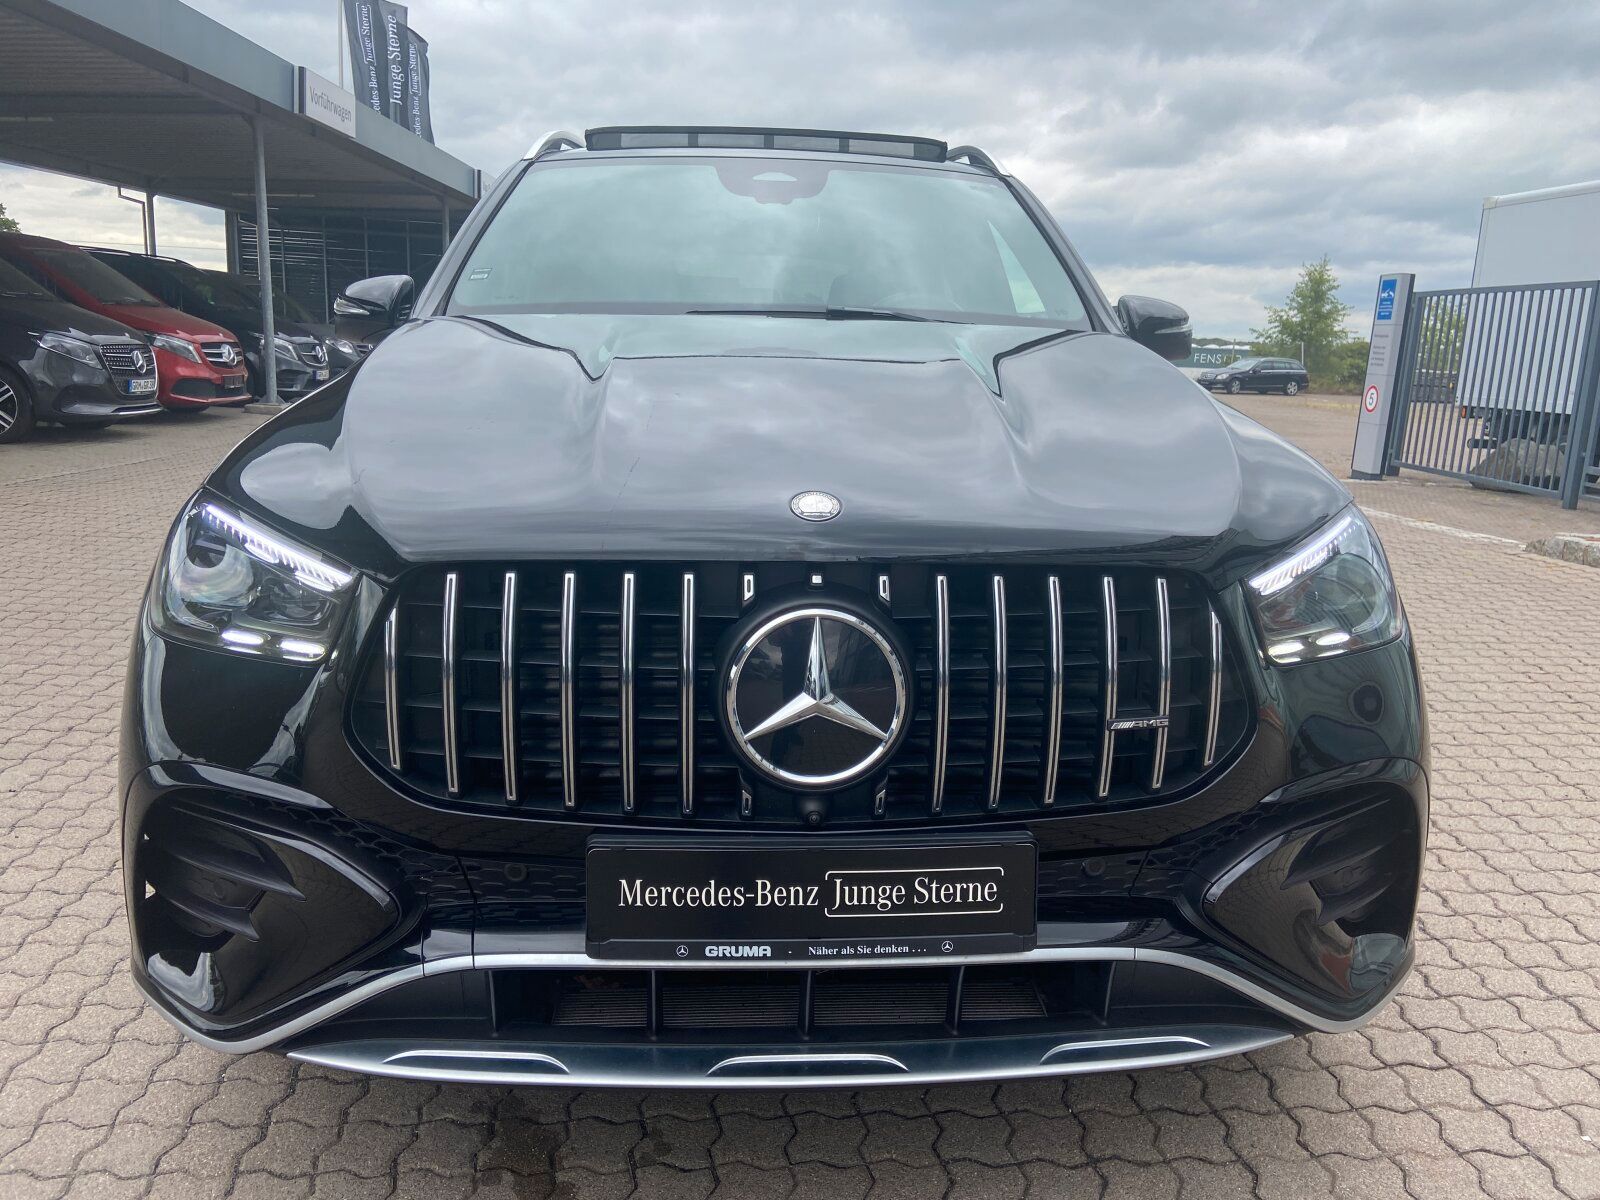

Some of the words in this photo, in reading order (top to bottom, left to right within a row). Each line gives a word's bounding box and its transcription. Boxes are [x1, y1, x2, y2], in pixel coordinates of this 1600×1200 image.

[360, 5, 370, 35] Sterne
[387, 15, 401, 60] Sterne
[364, 37, 374, 62] Junge
[368, 66, 381, 114] edes-Benz
[390, 64, 404, 105] Junge
[309, 86, 352, 123] Vorführwagen
[1132, 719, 1168, 728] AMG
[618, 879, 819, 907] Mercedes-Benz
[832, 878, 906, 911] Junge
[913, 876, 998, 904] Sterne
[705, 945, 771, 957] GRUMA
[808, 946, 838, 956] Näher
[841, 945, 854, 955] als
[857, 945, 872, 954] Sie
[874, 944, 909, 954] denken
